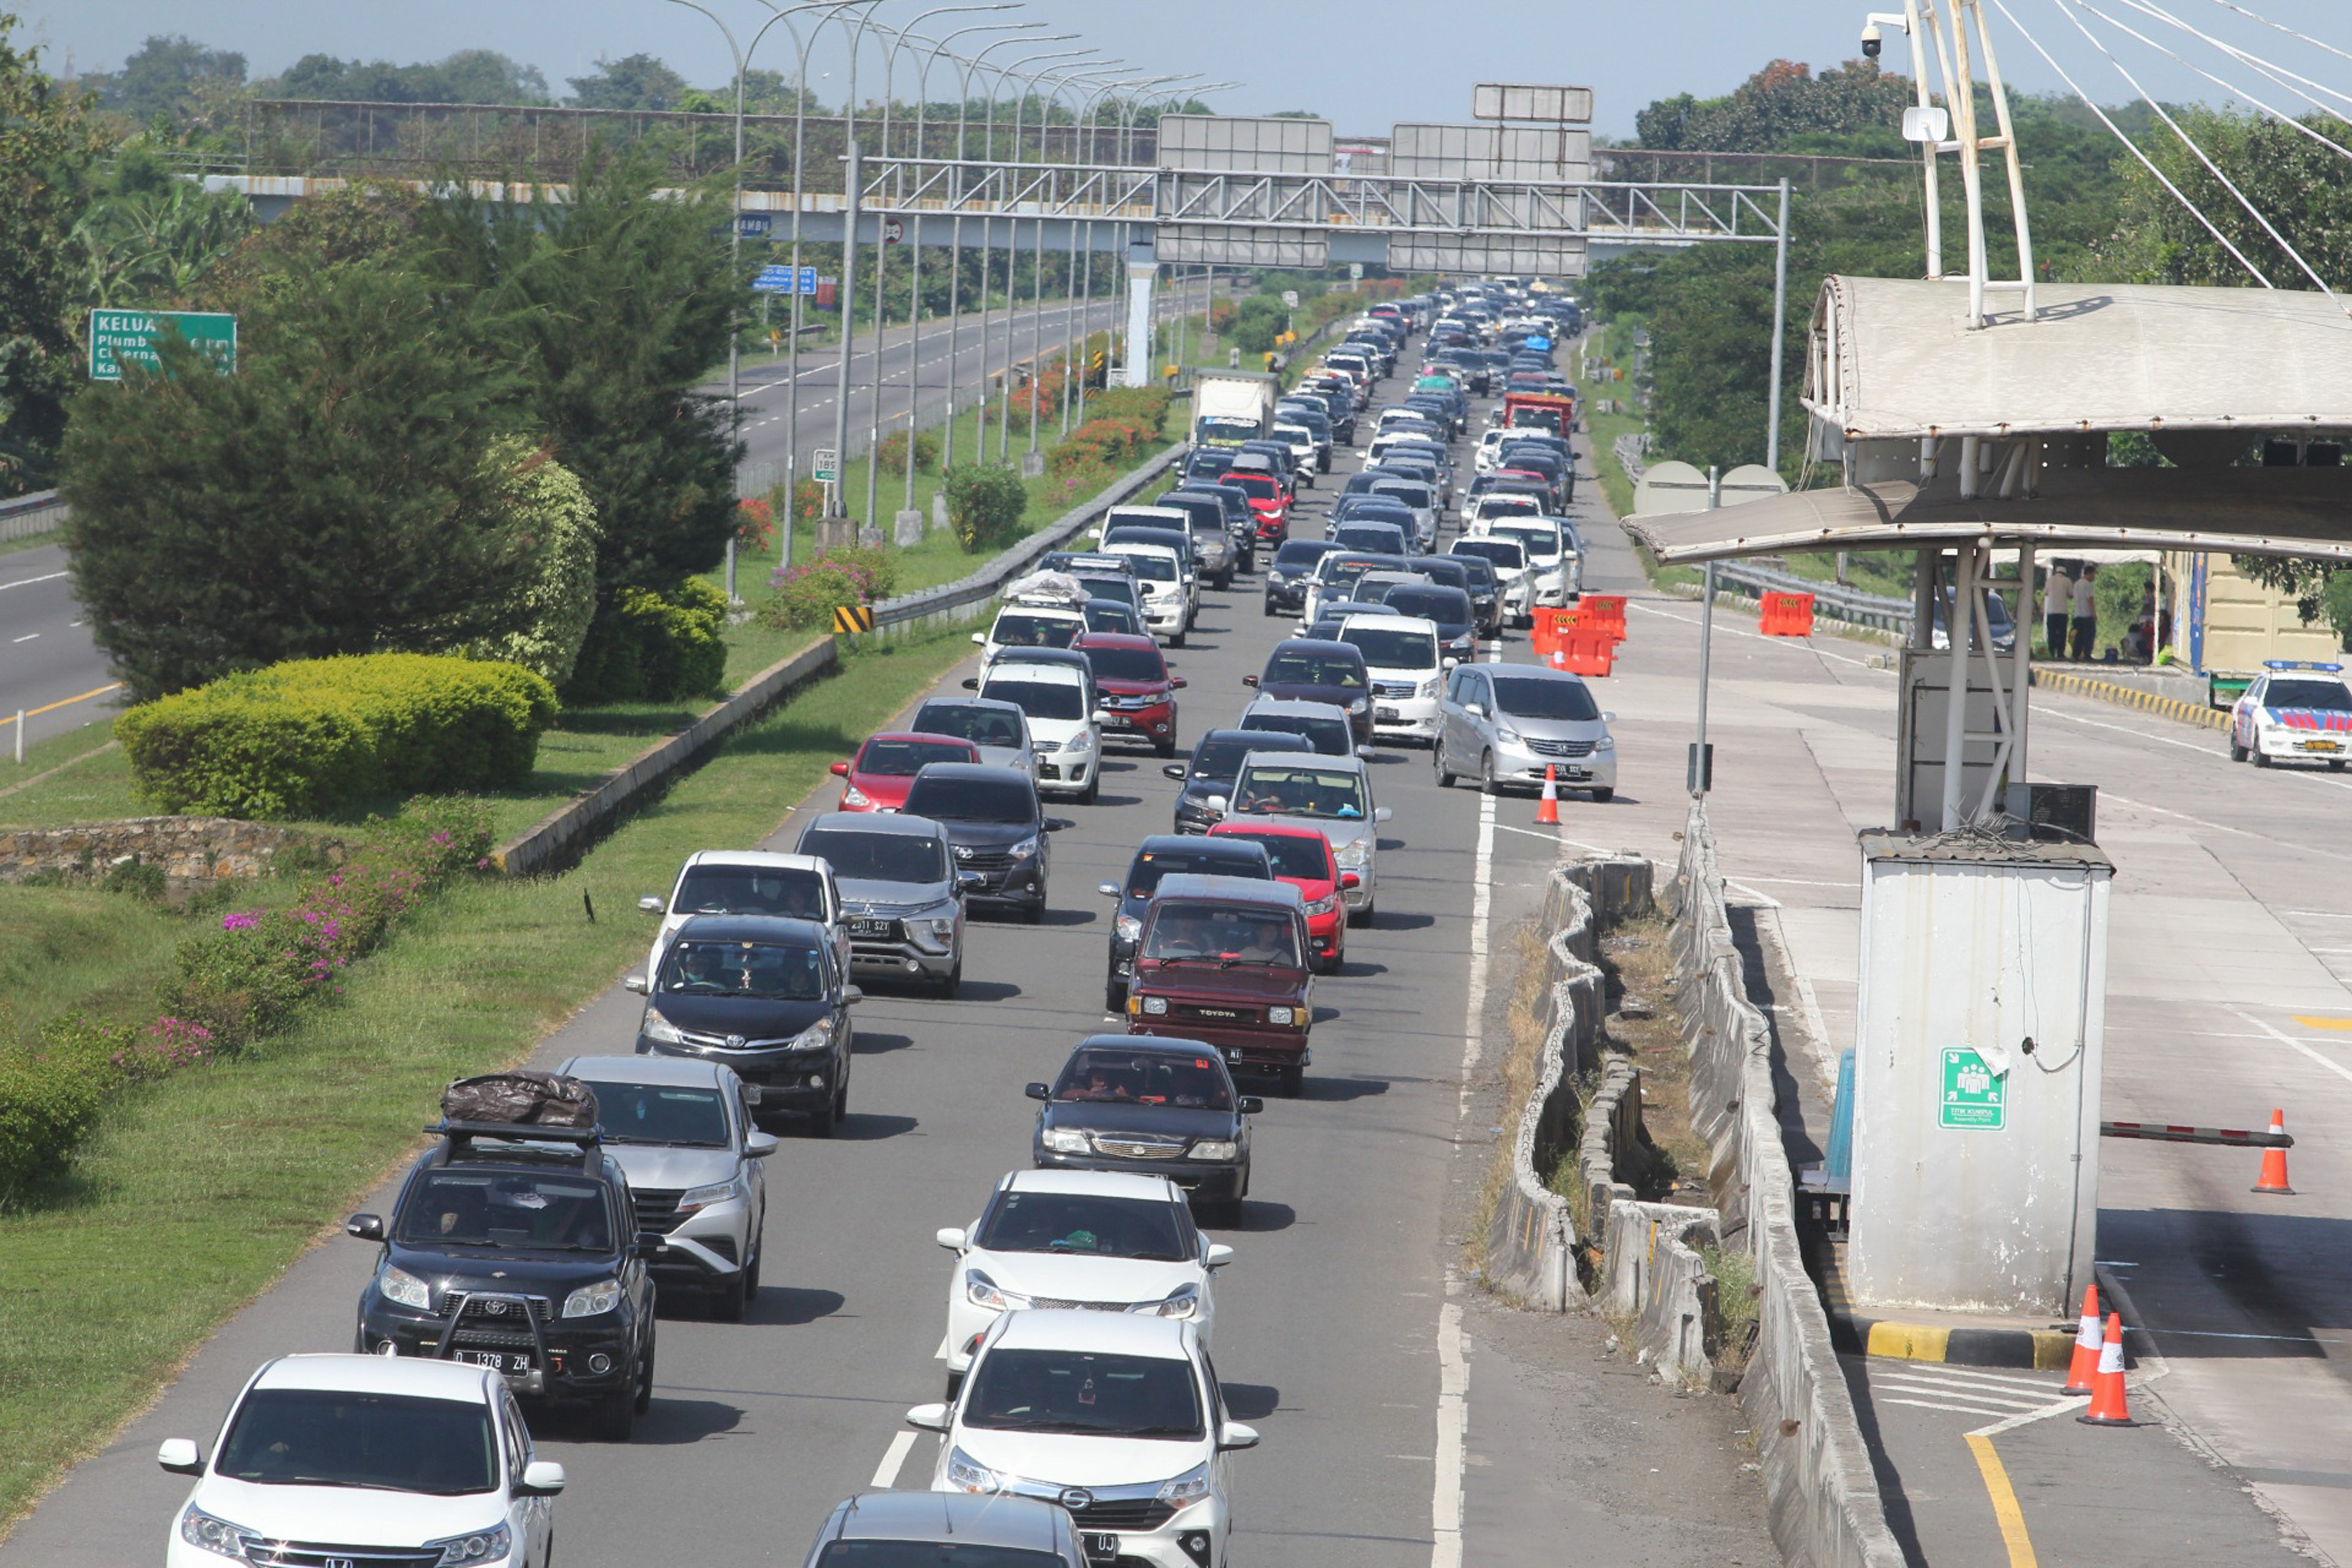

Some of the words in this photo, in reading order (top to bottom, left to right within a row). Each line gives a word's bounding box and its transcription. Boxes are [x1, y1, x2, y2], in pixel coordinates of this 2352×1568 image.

[98, 316, 158, 332] KELUA
[98, 335, 148, 347] Plumb
[98, 347, 159, 360] Cierna
[1199, 1009, 1236, 1018] TOYOTA
[477, 1353, 502, 1368] 1378
[513, 1356, 527, 1370] ZH
[1098, 1534, 1114, 1551] UJ
